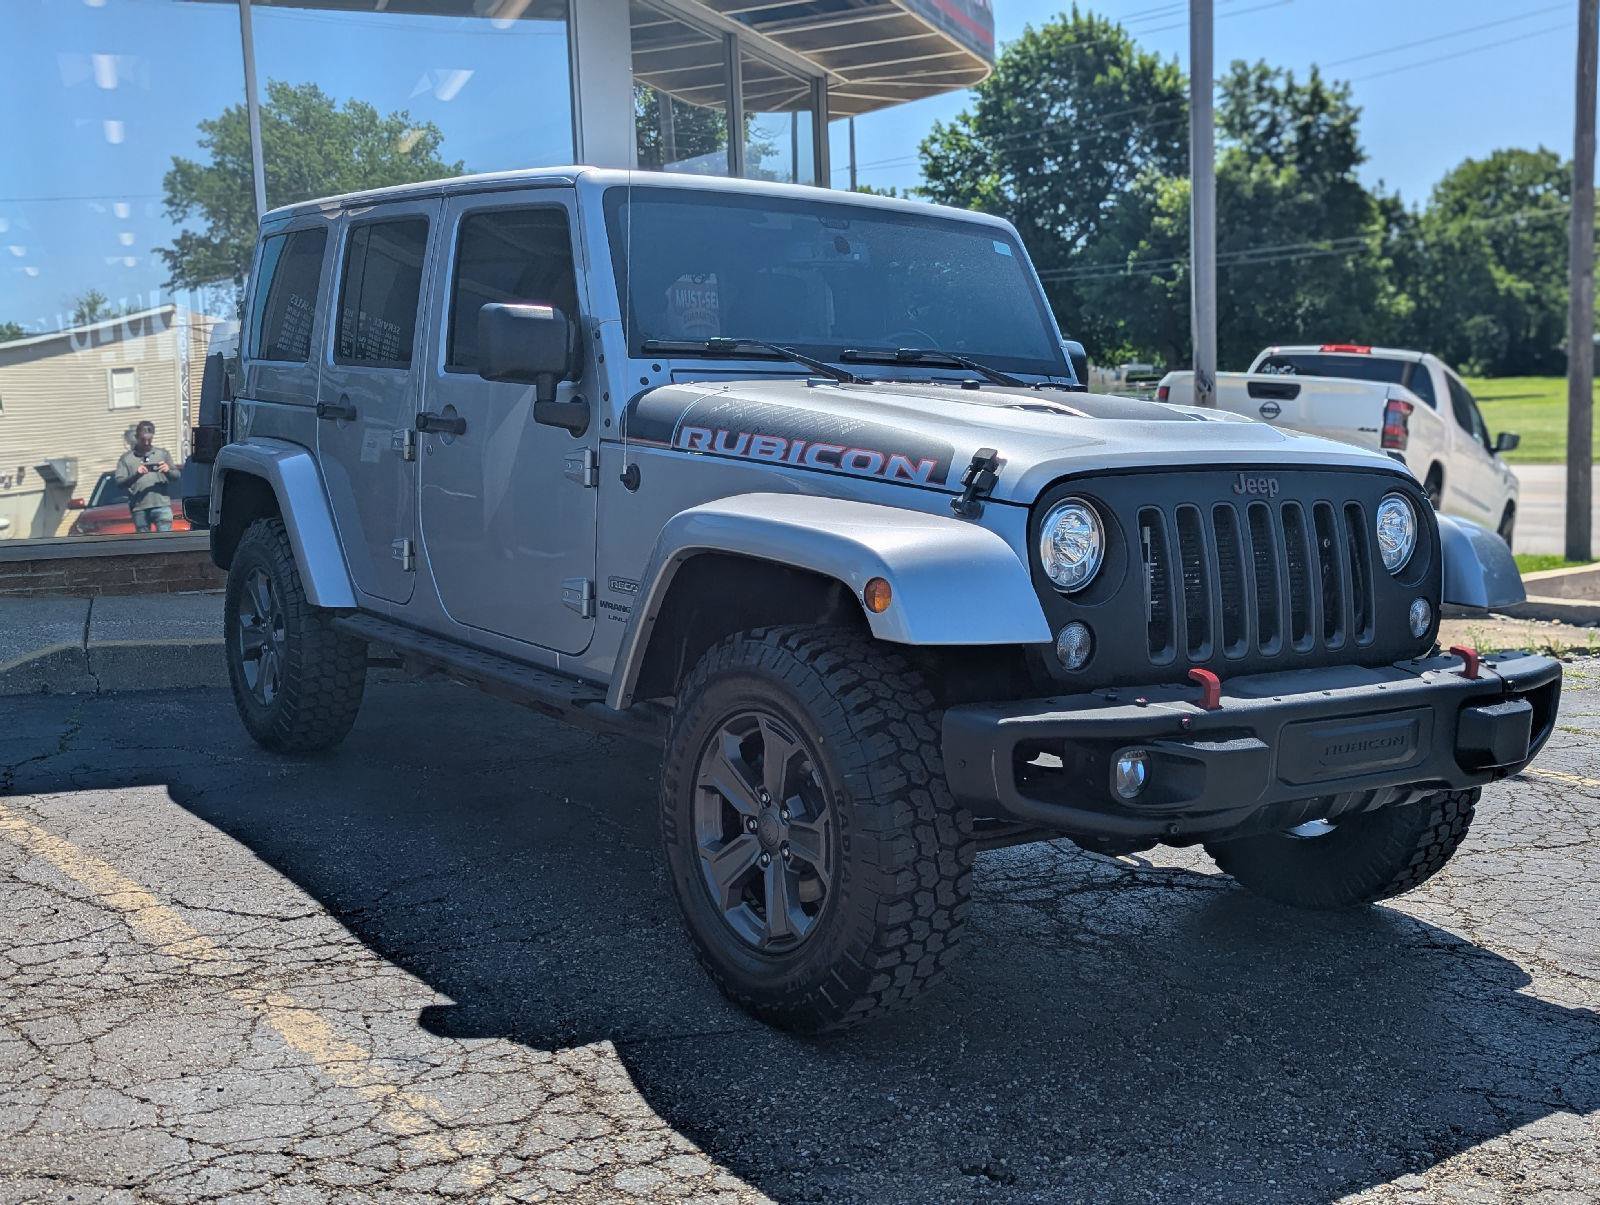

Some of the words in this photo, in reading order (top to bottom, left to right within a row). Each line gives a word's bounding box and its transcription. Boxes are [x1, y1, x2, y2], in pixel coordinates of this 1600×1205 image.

[678, 425, 937, 485] RUBICON
[1233, 473, 1279, 498] Jeep
[1325, 735, 1405, 756] RUBICON
